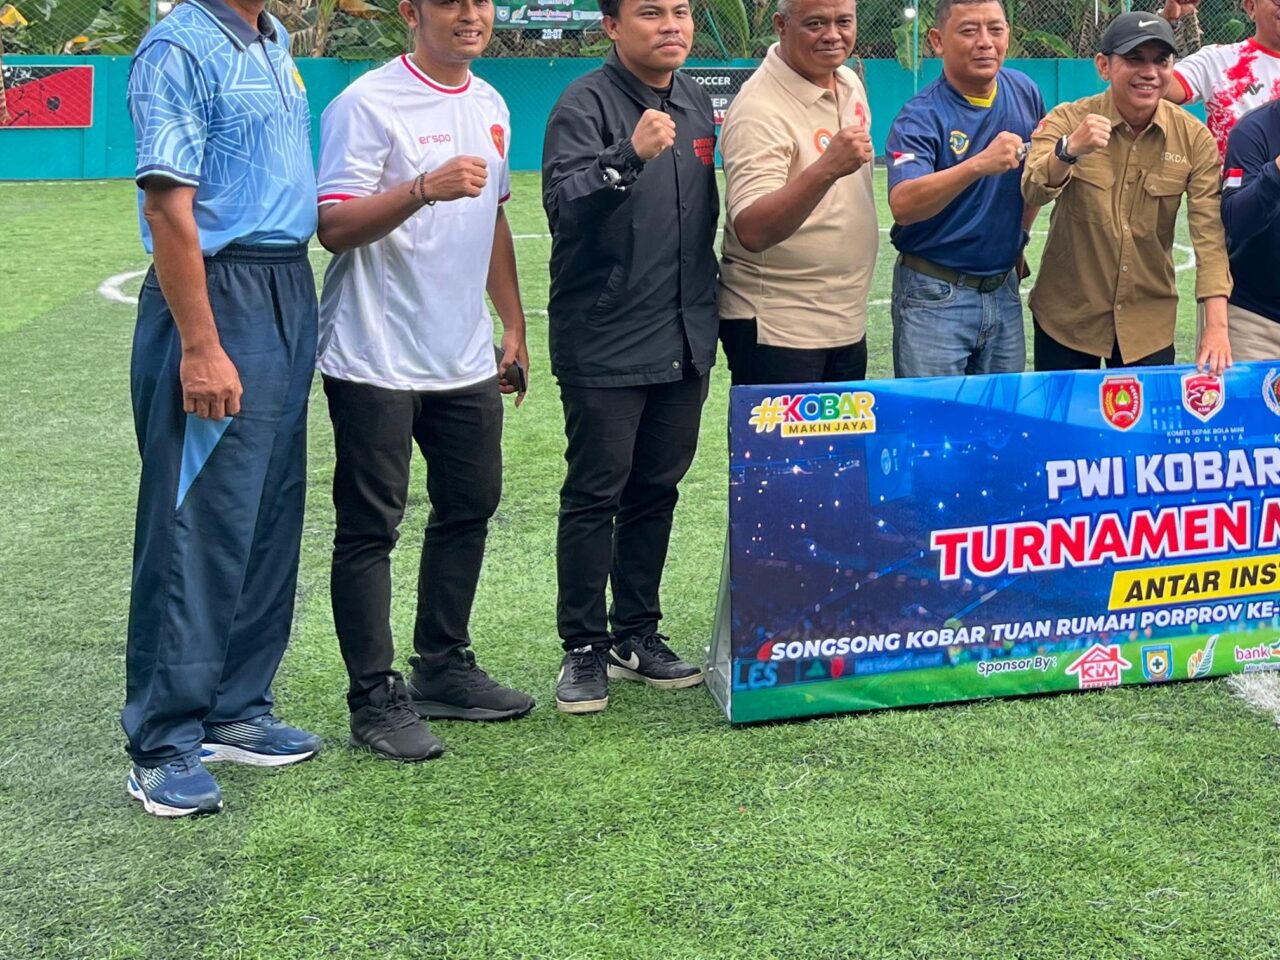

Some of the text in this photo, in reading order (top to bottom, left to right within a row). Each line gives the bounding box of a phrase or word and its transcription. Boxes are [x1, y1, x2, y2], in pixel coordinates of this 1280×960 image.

[419, 133, 451, 145] erspo
[749, 391, 875, 433] #KOBAR
[788, 421, 868, 434] MAKIN JAYA
[1166, 429, 1190, 437] KOMITE
[1045, 456, 1124, 501] PWI
[932, 501, 1249, 579] TURNAMEN
[1124, 570, 1220, 603] ANTAR
[770, 632, 901, 661] SONGSONG
[905, 625, 985, 649] KOBAR
[991, 620, 1051, 642] TUAN
[1056, 612, 1135, 636] RUMAH
[1140, 600, 1243, 629] PORPROV
[1235, 644, 1269, 660] bank
[977, 656, 1032, 675] Sponsor
